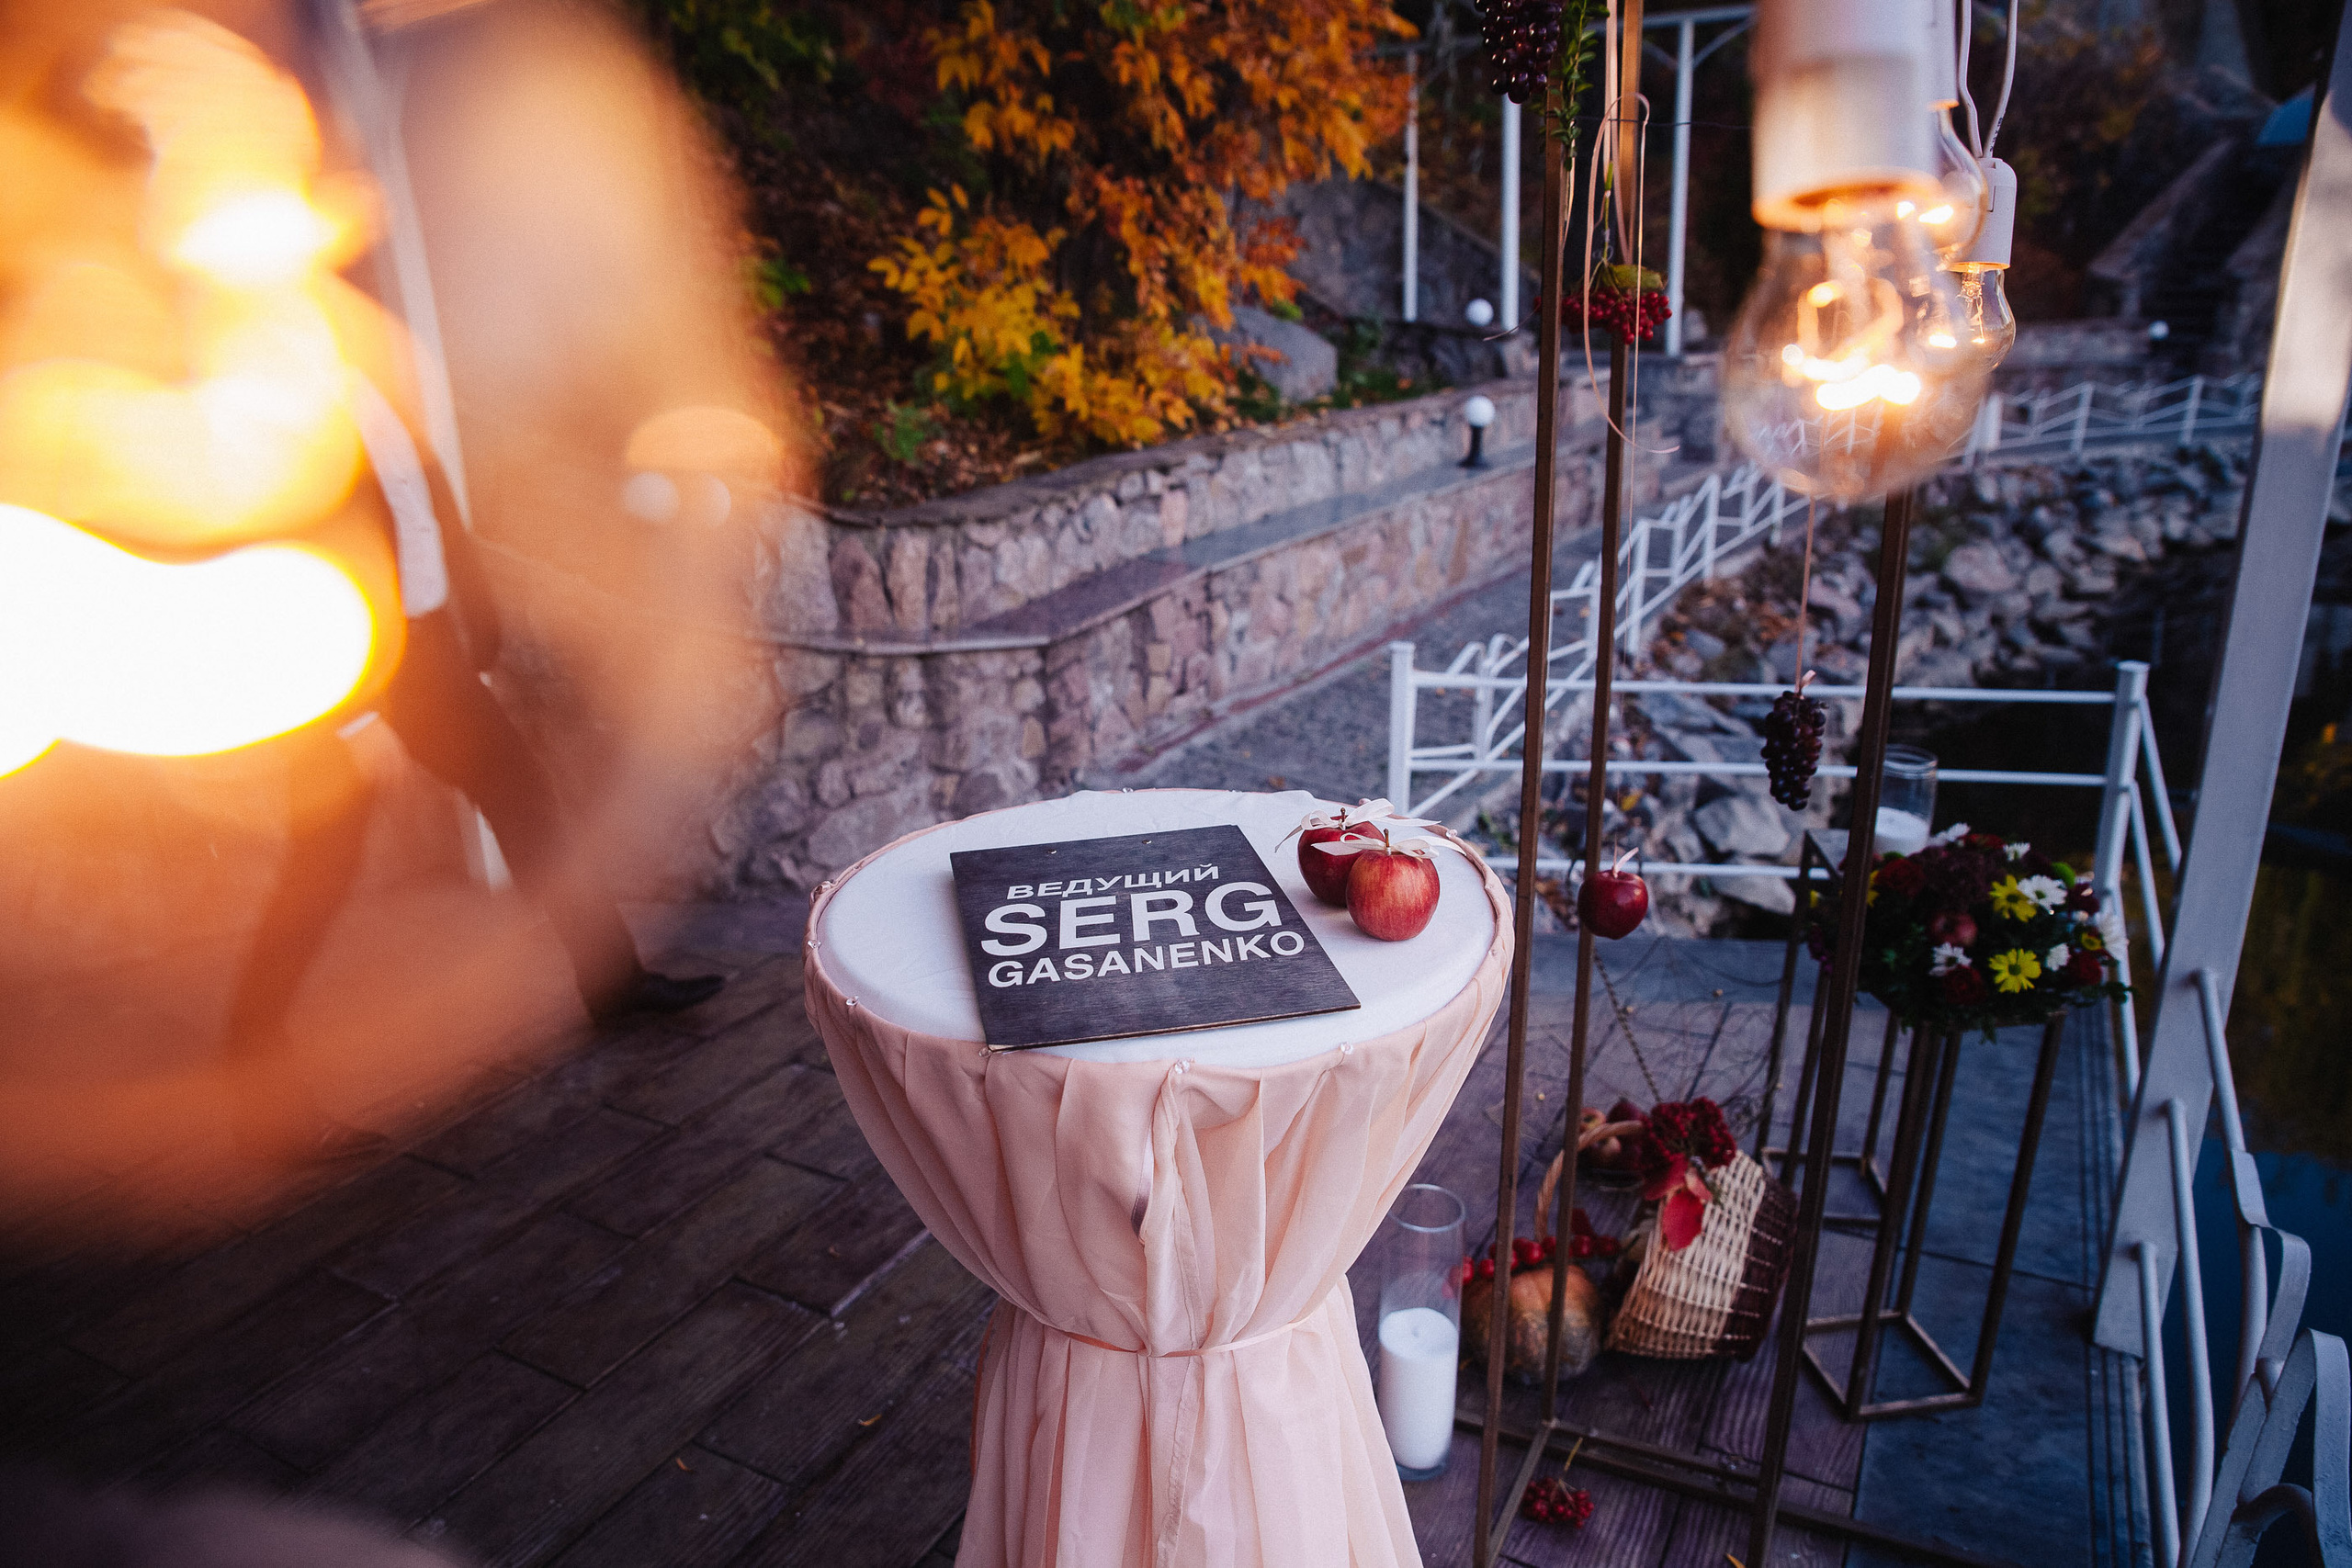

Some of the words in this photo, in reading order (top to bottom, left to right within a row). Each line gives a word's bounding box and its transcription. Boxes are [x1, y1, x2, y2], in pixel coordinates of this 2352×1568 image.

[1006, 863, 1219, 900] ВЕДУЩИЙ
[980, 881, 1283, 957] SERG
[988, 931, 1305, 988] GASANENKO
